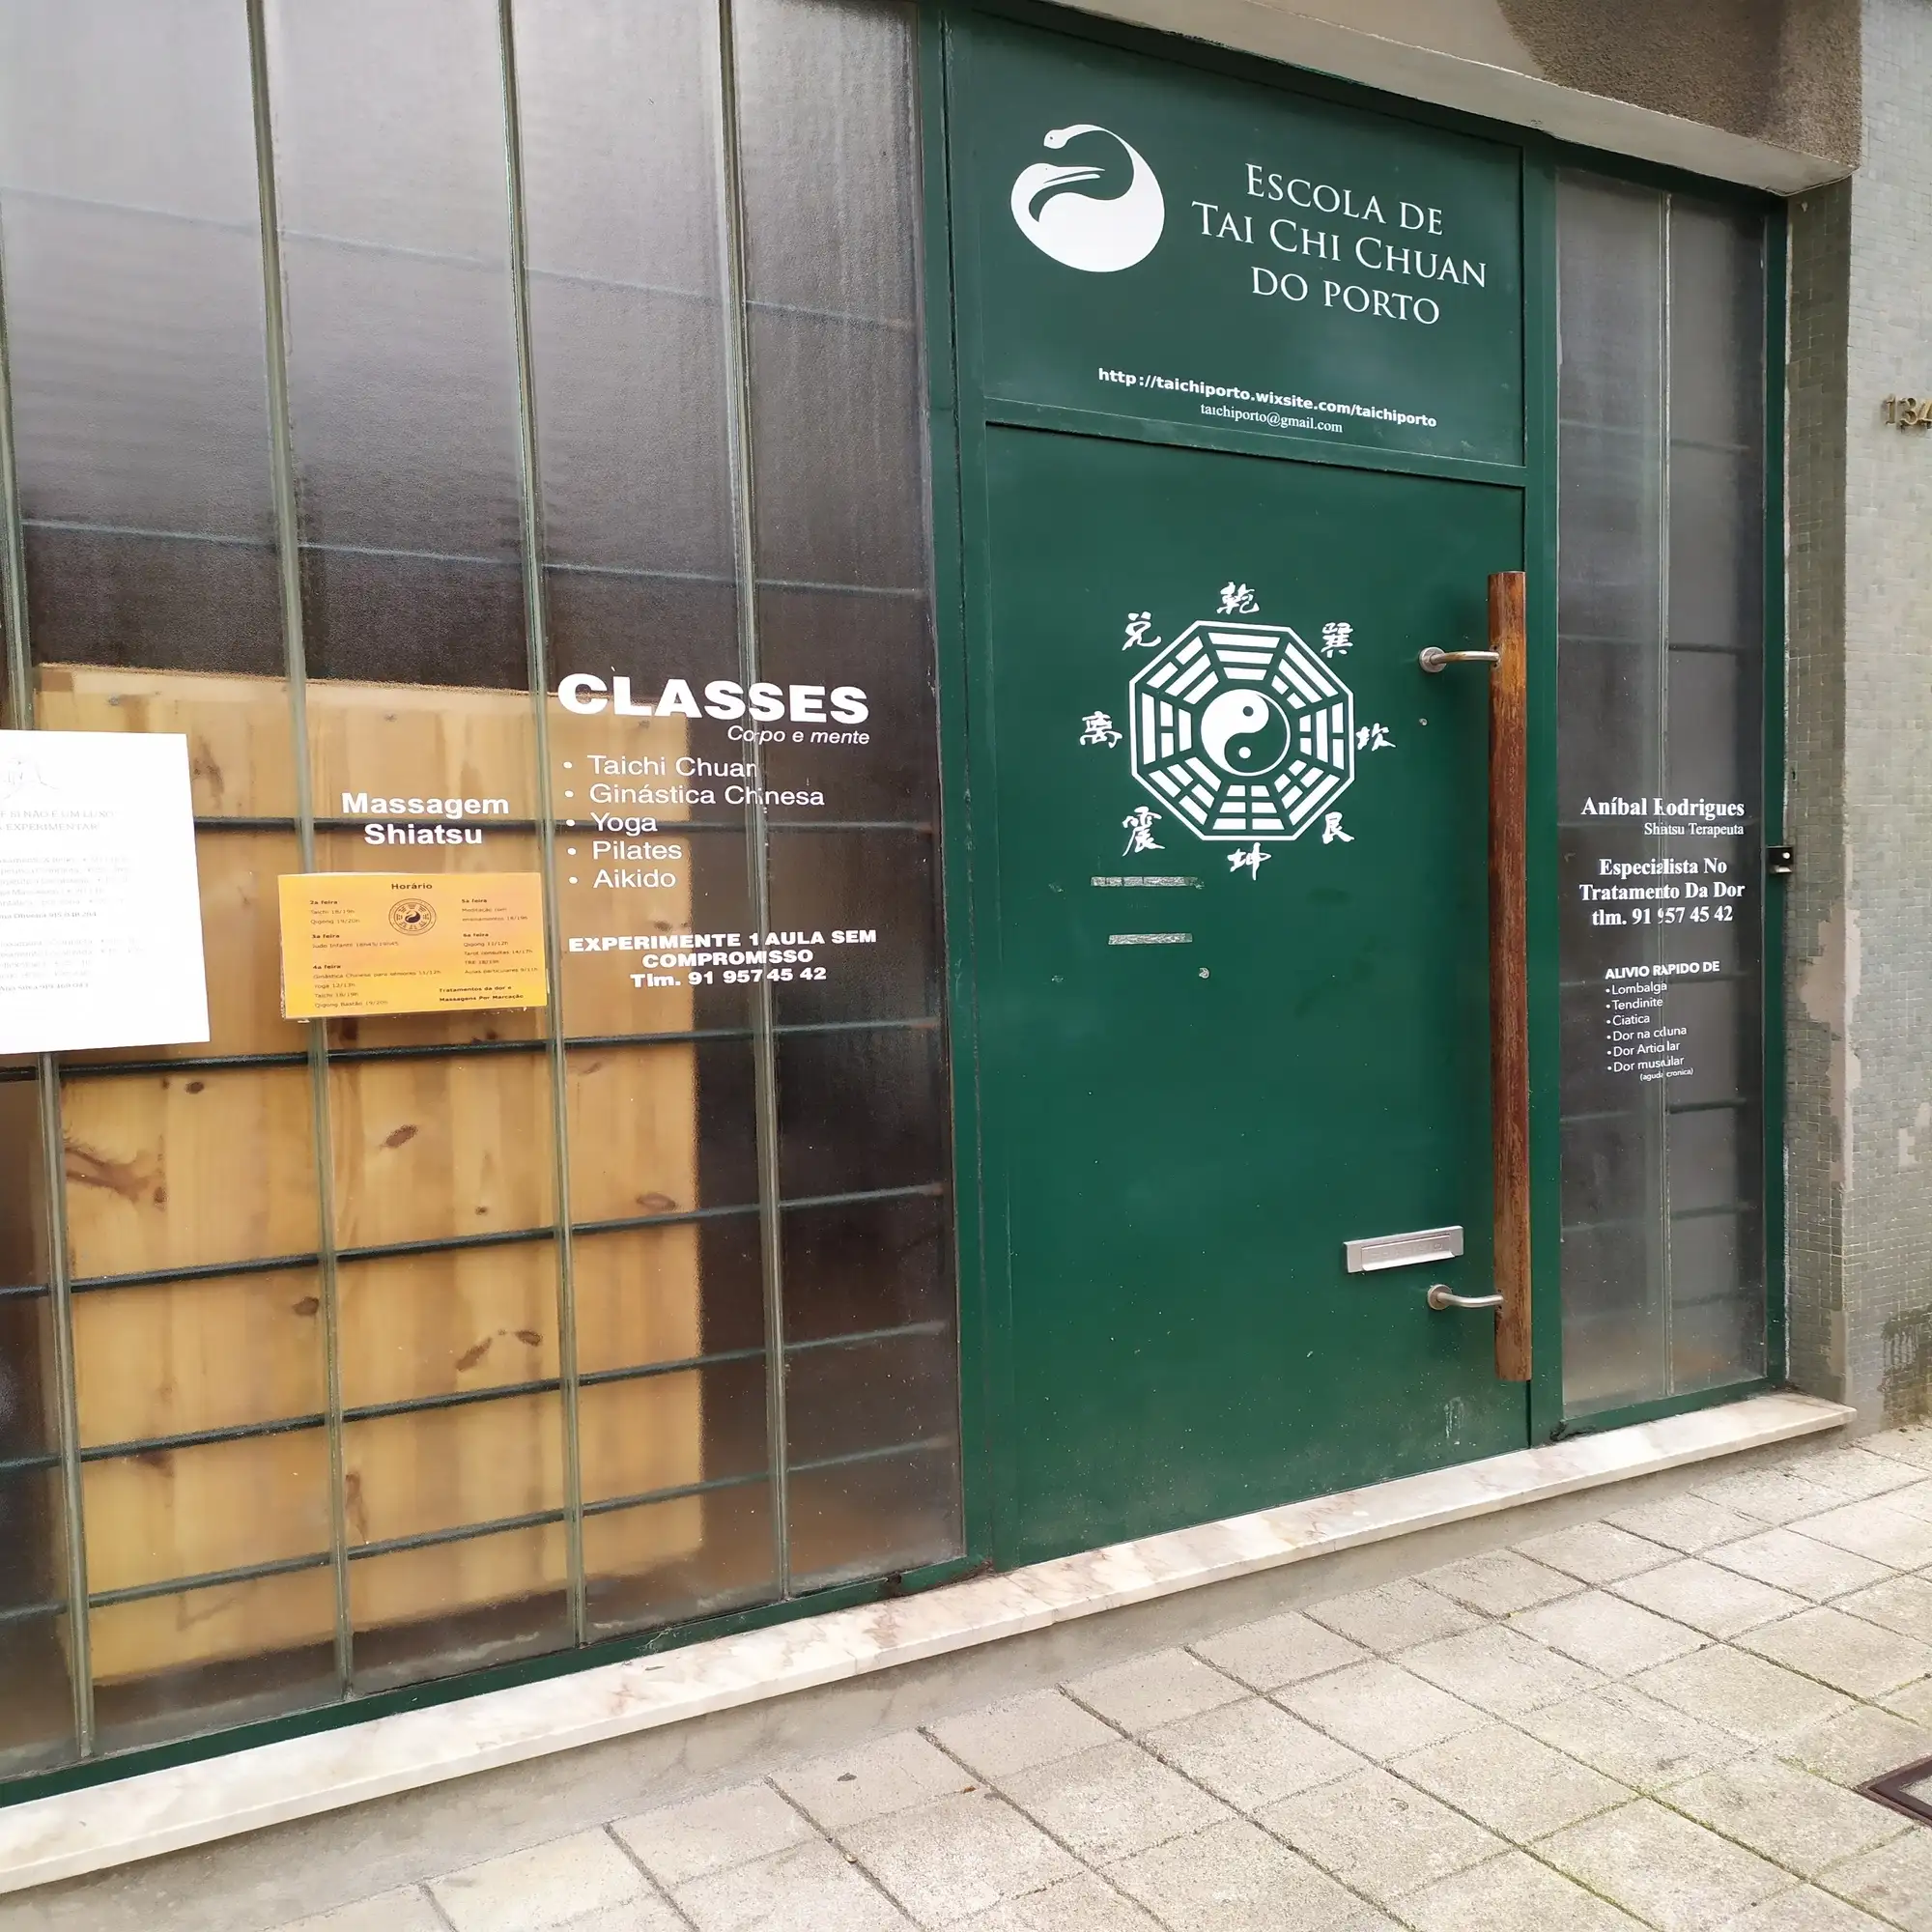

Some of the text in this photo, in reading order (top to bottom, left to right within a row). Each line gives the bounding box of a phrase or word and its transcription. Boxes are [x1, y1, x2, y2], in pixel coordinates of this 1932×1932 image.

[1245, 162, 1444, 237] ESCOLA DE
[1191, 200, 1487, 288] TAI CHI CHUAN
[1251, 266, 1440, 326] DO PORTO
[1200, 401, 1344, 434] taichiporto@gmail.com
[557, 673, 869, 724] CLASSES
[727, 725, 870, 746] Corpo e mente
[587, 754, 758, 778] Taichi Chuan
[589, 782, 717, 805] Ginástica
[341, 792, 509, 819] Massagem
[1580, 796, 1746, 821] Aníbal Rodrigues
[364, 823, 483, 845] Shiatsu
[590, 811, 658, 837] Yoga
[1688, 822, 1745, 838] Terapeuta
[592, 840, 683, 860] Pilates
[592, 868, 677, 889] Aikido
[1599, 857, 1727, 880] Especialista No
[1579, 881, 1746, 901] Tratamento Da Dor
[1592, 905, 1734, 926] tlm. 91 957 45 42
[568, 929, 876, 952] EXPERIMENTE 1 AULA SEM
[642, 950, 813, 968] COMPROMISSO
[630, 967, 826, 988] Tlm. 91 957 45 42
[1605, 961, 1720, 980] ALIVIO RAPIDO DE
[1611, 997, 1663, 1010] Tendinite
[1612, 1014, 1650, 1027] Ciatica
[1612, 1031, 1634, 1042] Dor
[1636, 1030, 1651, 1039] na
[1613, 1046, 1635, 1058] Dor
[1613, 1062, 1635, 1073] Dor
